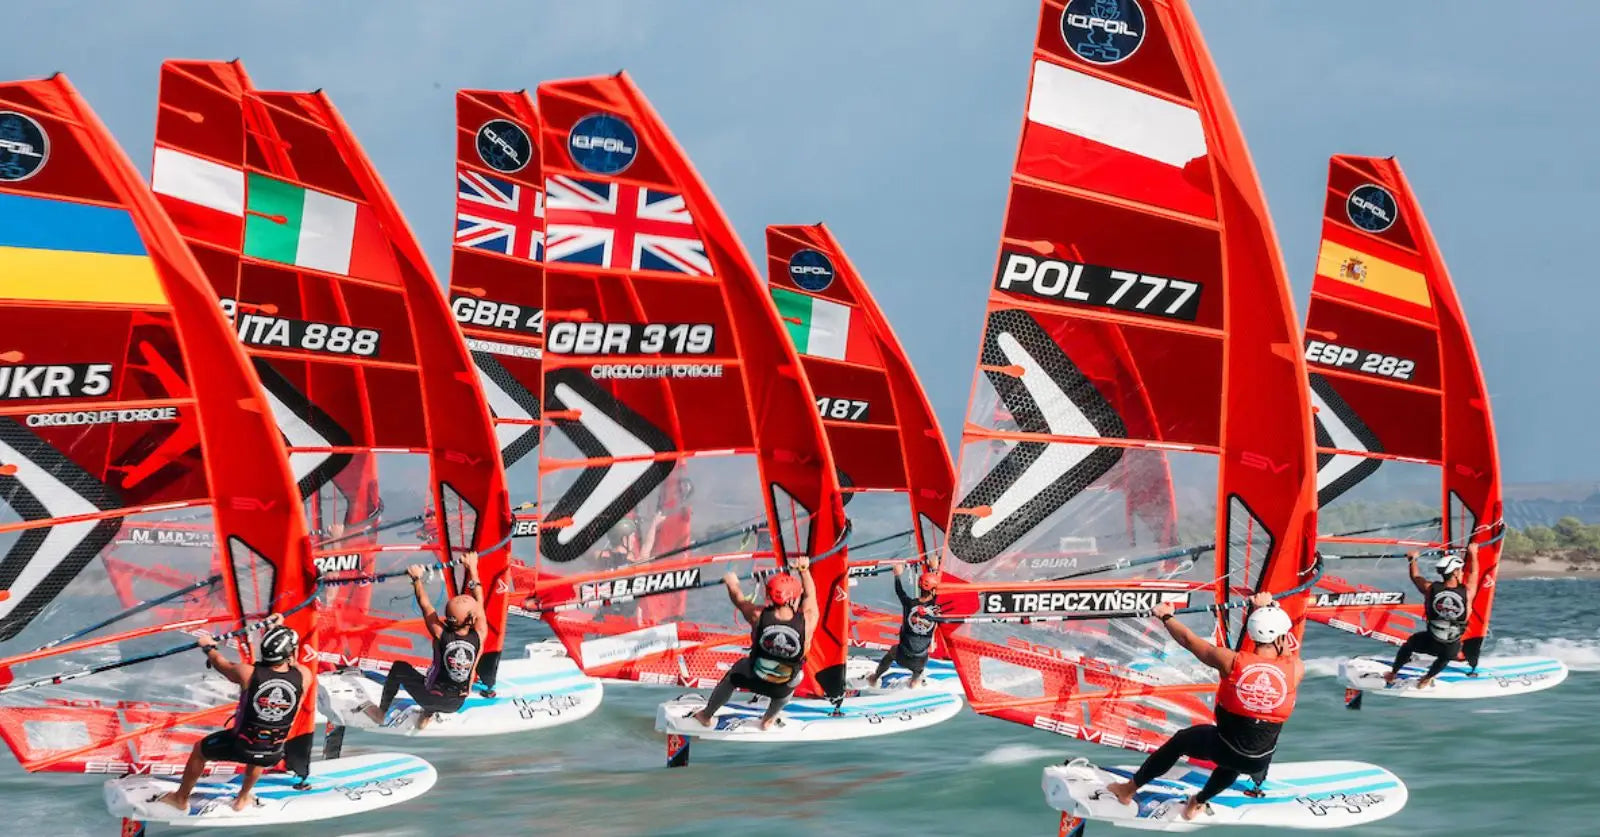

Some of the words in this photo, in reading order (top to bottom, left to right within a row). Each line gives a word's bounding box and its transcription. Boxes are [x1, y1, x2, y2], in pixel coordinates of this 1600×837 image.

[1000, 253, 1090, 301] POL
[1106, 269, 1198, 315] 777
[451, 296, 521, 329] GBR
[238, 314, 290, 347] ITA
[301, 322, 379, 356] 888
[548, 322, 631, 354] GBR
[640, 323, 714, 354] 319
[1304, 340, 1359, 367] ESP
[1360, 353, 1415, 380] 282
[81, 364, 112, 396] 5
[815, 397, 869, 420] 187
[987, 594, 1006, 613] S.
[1012, 590, 1163, 613] TREPCZYŃSKI
[1032, 715, 1161, 753] SEVERN
